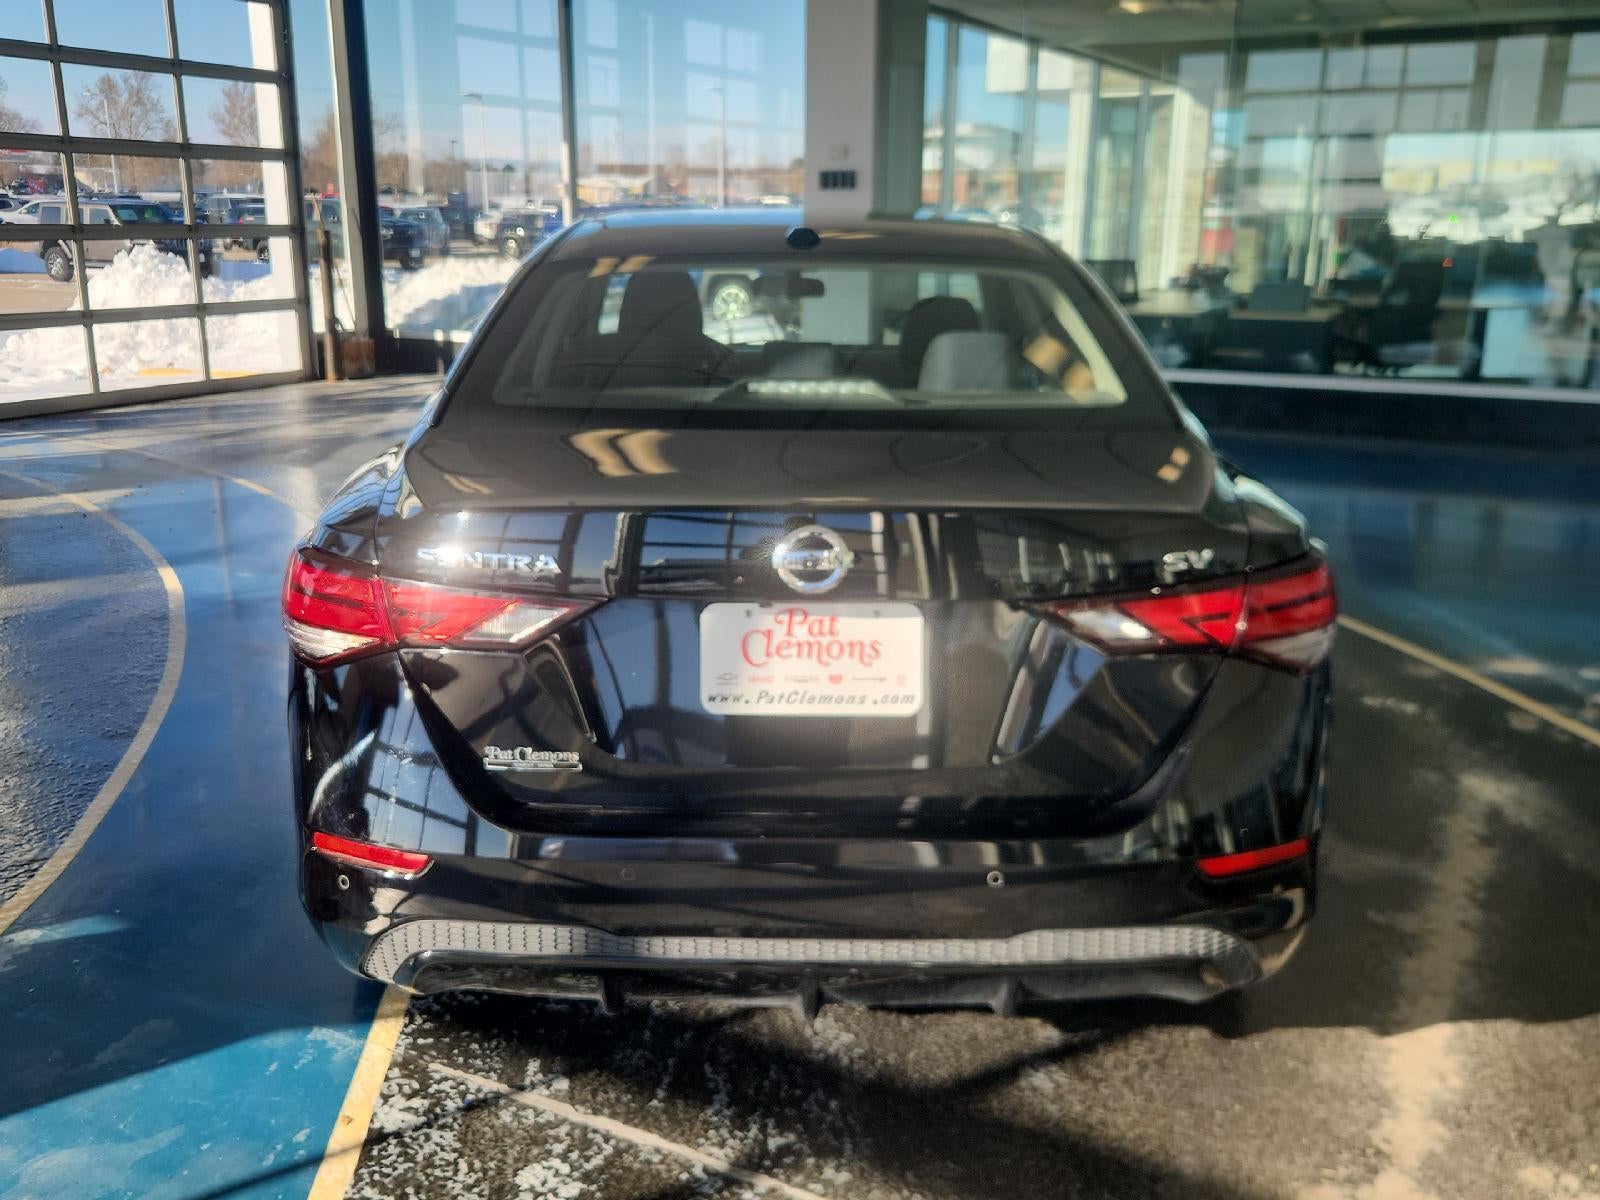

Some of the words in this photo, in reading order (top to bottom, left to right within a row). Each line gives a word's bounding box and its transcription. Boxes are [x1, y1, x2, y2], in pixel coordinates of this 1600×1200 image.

[416, 547, 563, 573] SNTRA
[1162, 548, 1215, 573] SV
[774, 606, 838, 637] Pat
[741, 628, 882, 667] Clemons
[483, 745, 513, 760] Pat
[514, 746, 580, 762] Clemons
